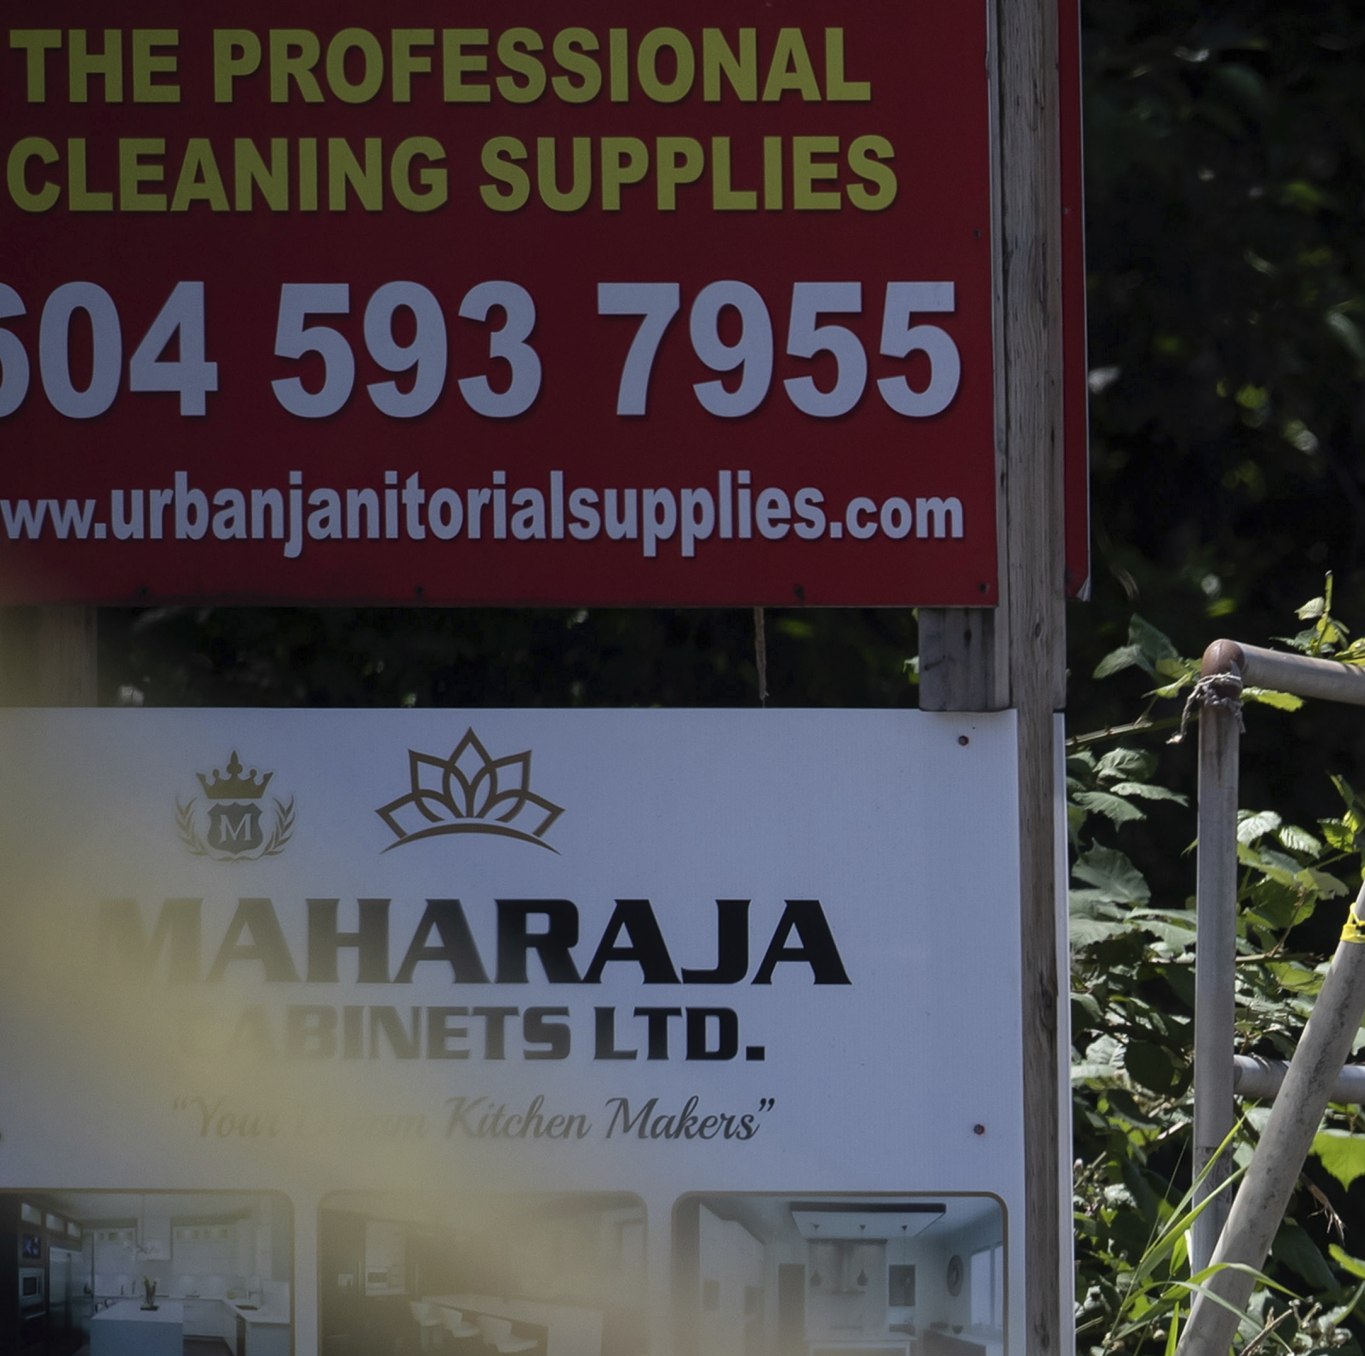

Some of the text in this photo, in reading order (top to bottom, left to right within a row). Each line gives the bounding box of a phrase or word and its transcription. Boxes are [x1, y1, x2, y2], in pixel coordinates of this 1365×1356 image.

[9, 26, 872, 104] THE PROFESSIONAL
[5, 134, 899, 212] CLEANING SUPPLIES
[270, 279, 544, 419] 593
[596, 279, 962, 419] 7955
[97, 897, 852, 986] MAHARAJA
[592, 1005, 767, 1062] LTD.
[445, 1095, 592, 1141] Kitchen
[602, 1095, 776, 1141] Makers”
